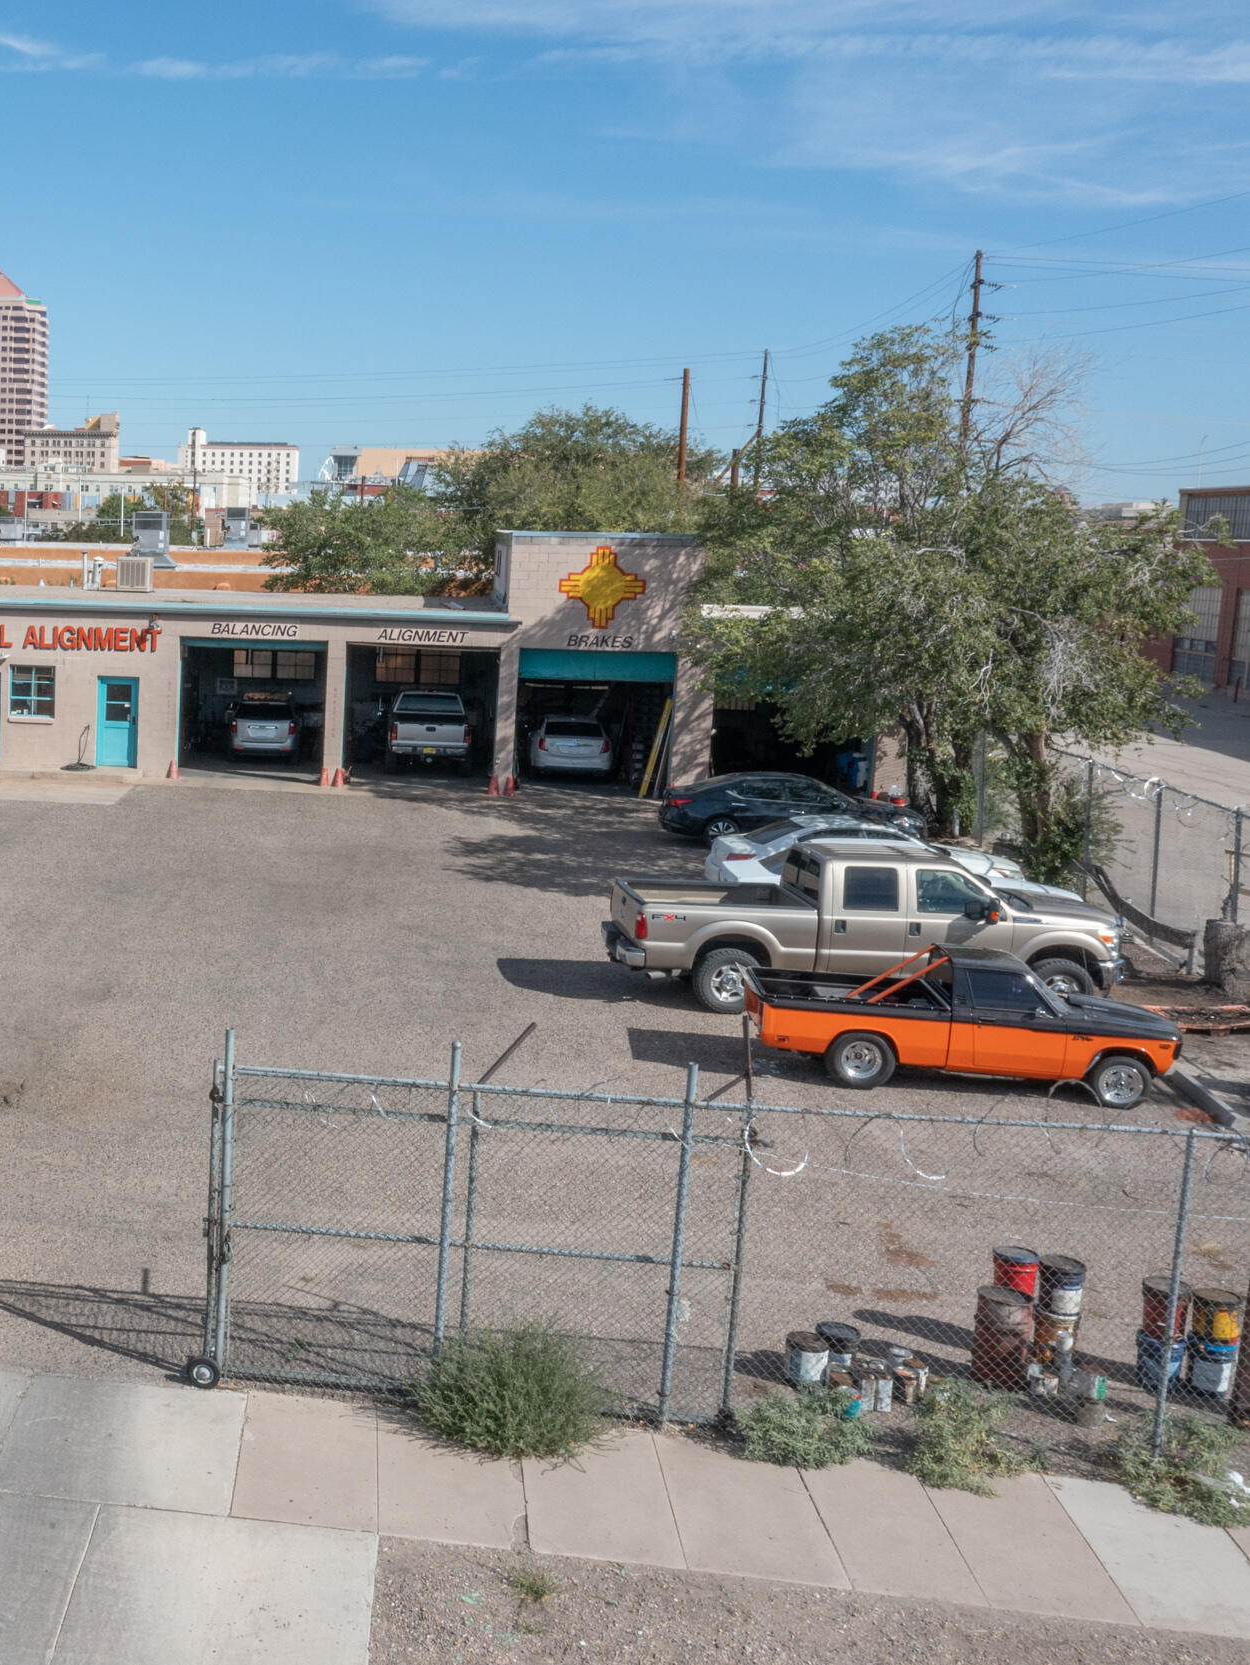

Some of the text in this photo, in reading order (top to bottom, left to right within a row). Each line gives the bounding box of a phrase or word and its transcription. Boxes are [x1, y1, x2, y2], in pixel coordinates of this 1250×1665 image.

[211, 623, 298, 637] BALANCING
[377, 629, 469, 643] ALIGNMENT
[22, 624, 163, 653] ALIGNMENT
[567, 635, 634, 649] BRAKES
[651, 913, 687, 921] FX4
